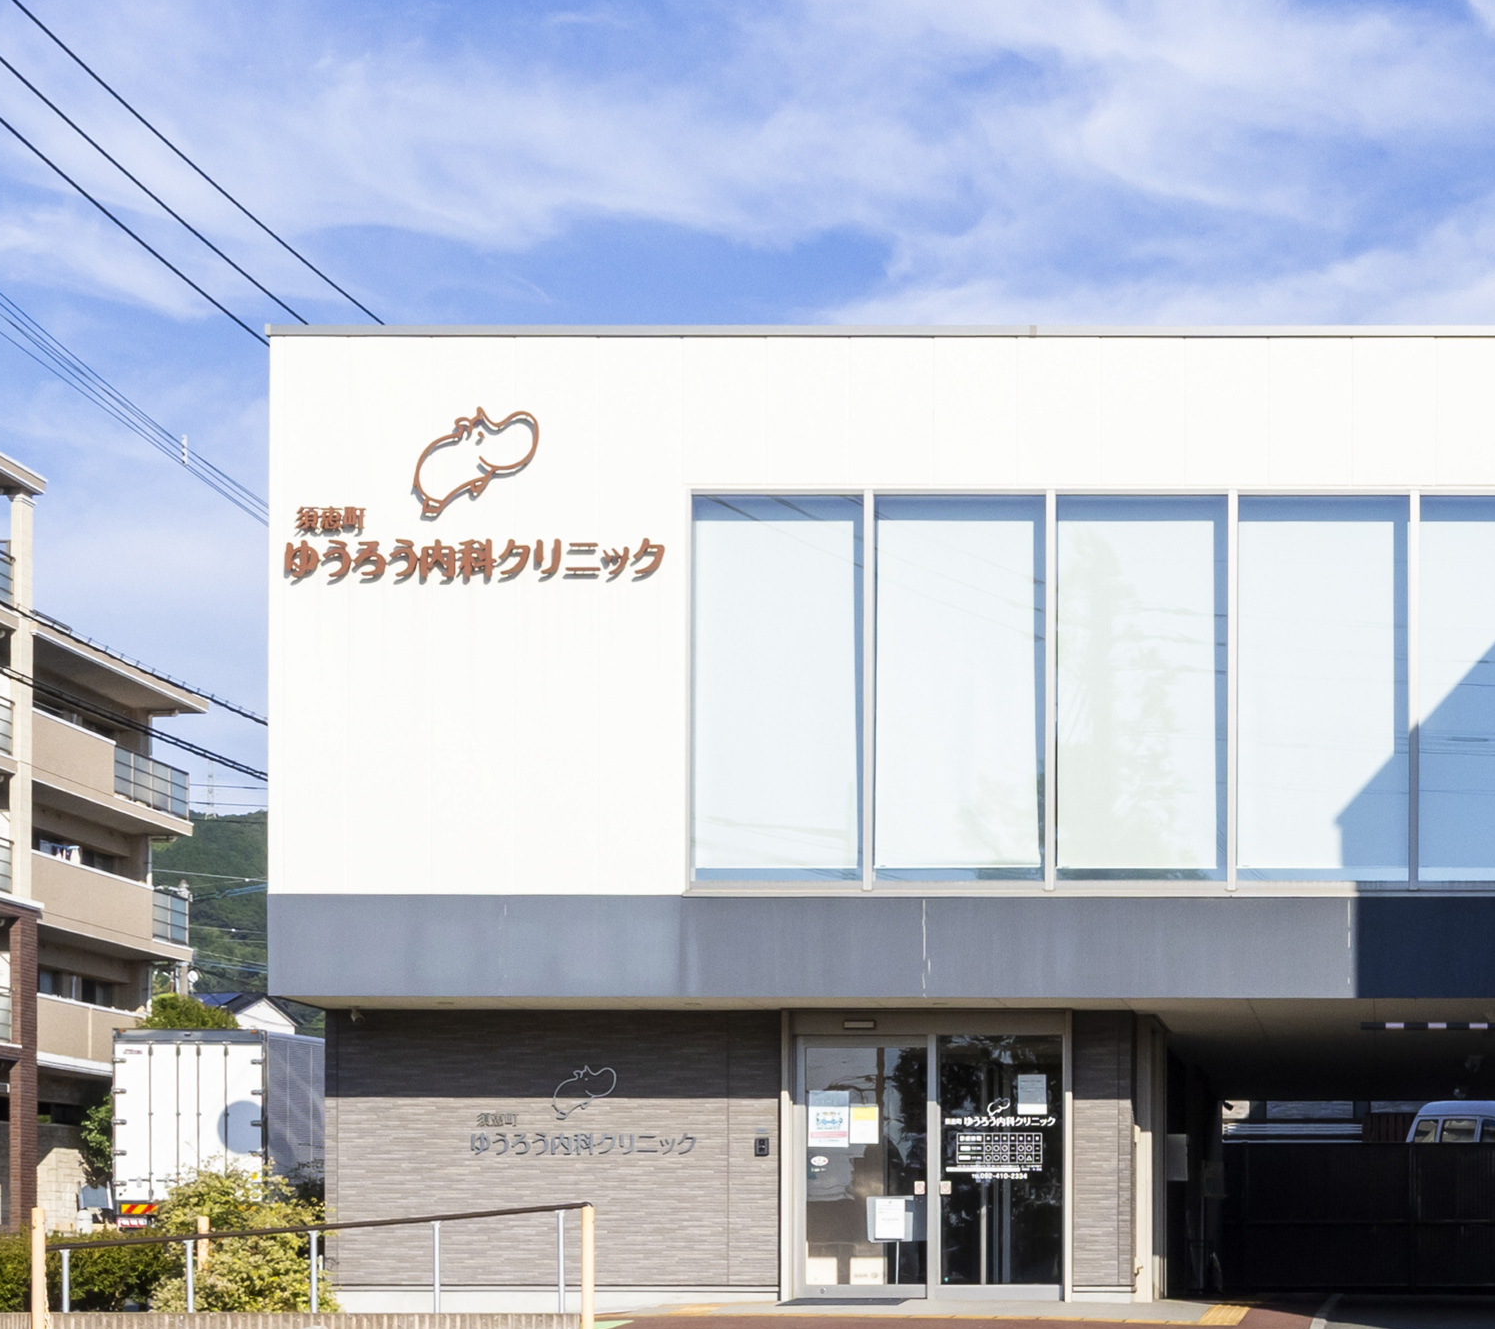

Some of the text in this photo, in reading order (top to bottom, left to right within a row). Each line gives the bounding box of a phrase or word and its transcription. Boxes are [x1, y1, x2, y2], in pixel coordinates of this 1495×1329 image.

[295, 505, 366, 531] 須恵町
[285, 538, 666, 580] ゆうろう内科クリニック
[470, 1132, 697, 1156] ゆうろう内科クリニック
